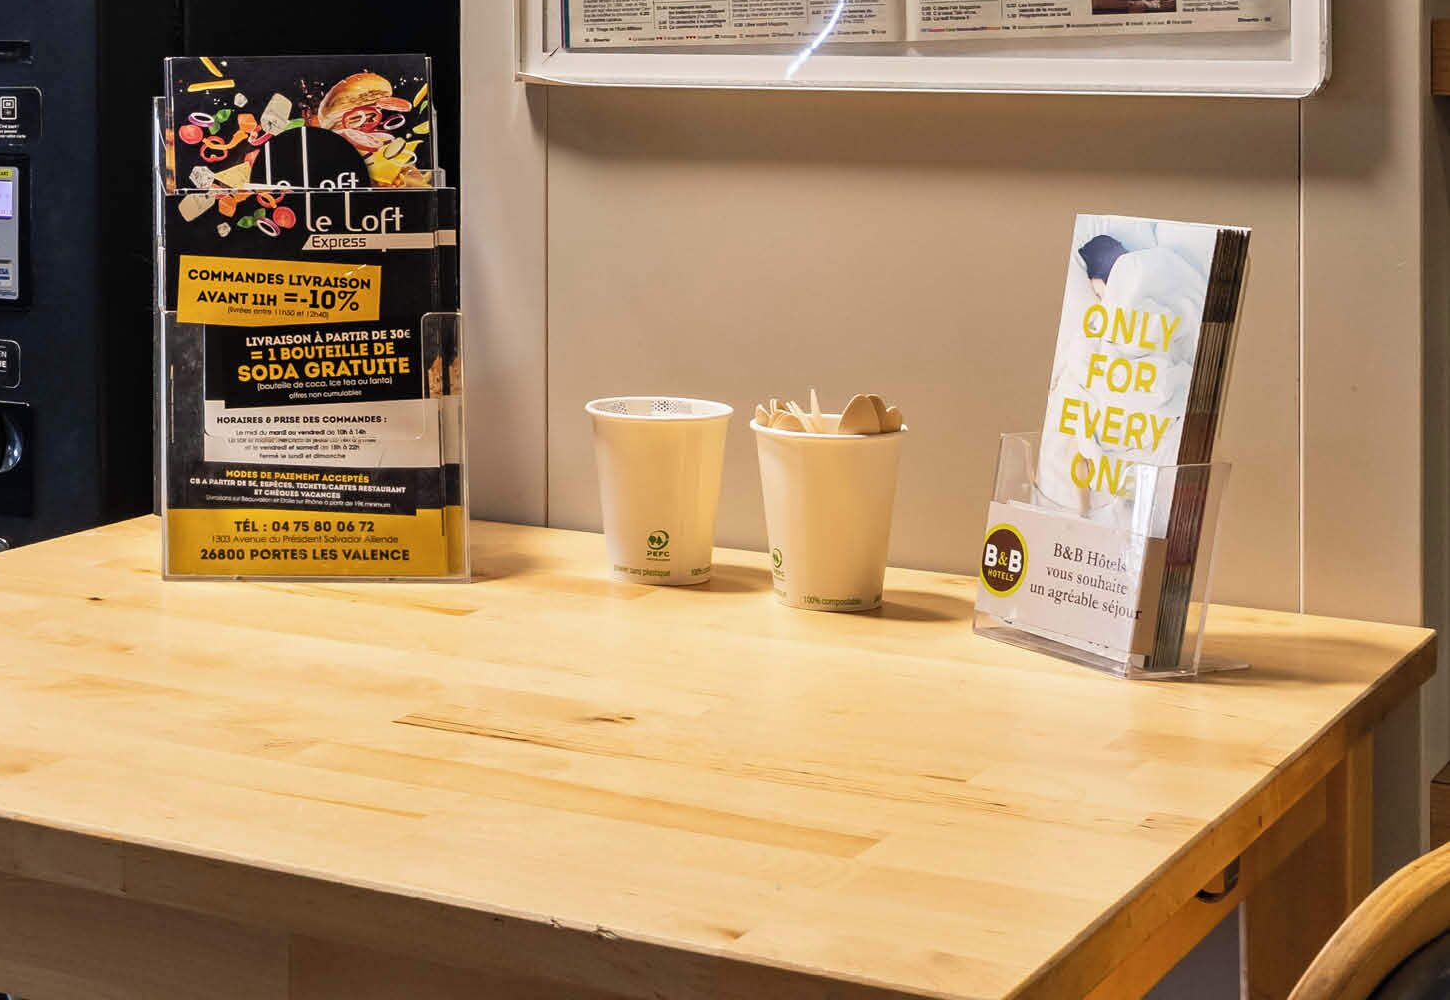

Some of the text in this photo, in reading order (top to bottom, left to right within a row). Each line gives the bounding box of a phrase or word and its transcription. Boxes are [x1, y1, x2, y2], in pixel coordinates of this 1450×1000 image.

[312, 235, 366, 251] Express
[188, 268, 371, 291] COMMANDES LIVRAISON
[197, 291, 250, 305] AVANT
[252, 293, 277, 307] 11H
[1082, 303, 1181, 352] ONLY
[246, 328, 412, 348] LIVRAISON À PARTIR DE 30€
[281, 344, 371, 361] BOUTEILLE
[374, 342, 394, 356] DE
[238, 357, 410, 382] SODA GRATUITE
[1085, 352, 1158, 394] FOR
[217, 416, 263, 424] HORAIRES
[274, 416, 300, 424] PRISE
[302, 416, 320, 424] DES
[322, 415, 381, 423] COMMANDES
[1059, 397, 1171, 451] EVERY
[226, 470, 369, 483] MODES DE PAIEMENT ACCEPTÉS
[234, 520, 374, 533] TÉL 04 75 80 06 72
[212, 534, 398, 544] 1303 Avenue du Président Salvador Allende
[200, 548, 410, 561] 26800 PORTES LES VALENCE
[984, 543, 1022, 573] B&B
[1053, 543, 1127, 573] B&B Hôtels
[987, 568, 1015, 582] HOTELS
[1046, 565, 1128, 595] vous souhaite
[1030, 583, 1142, 620] un agréable séjour
